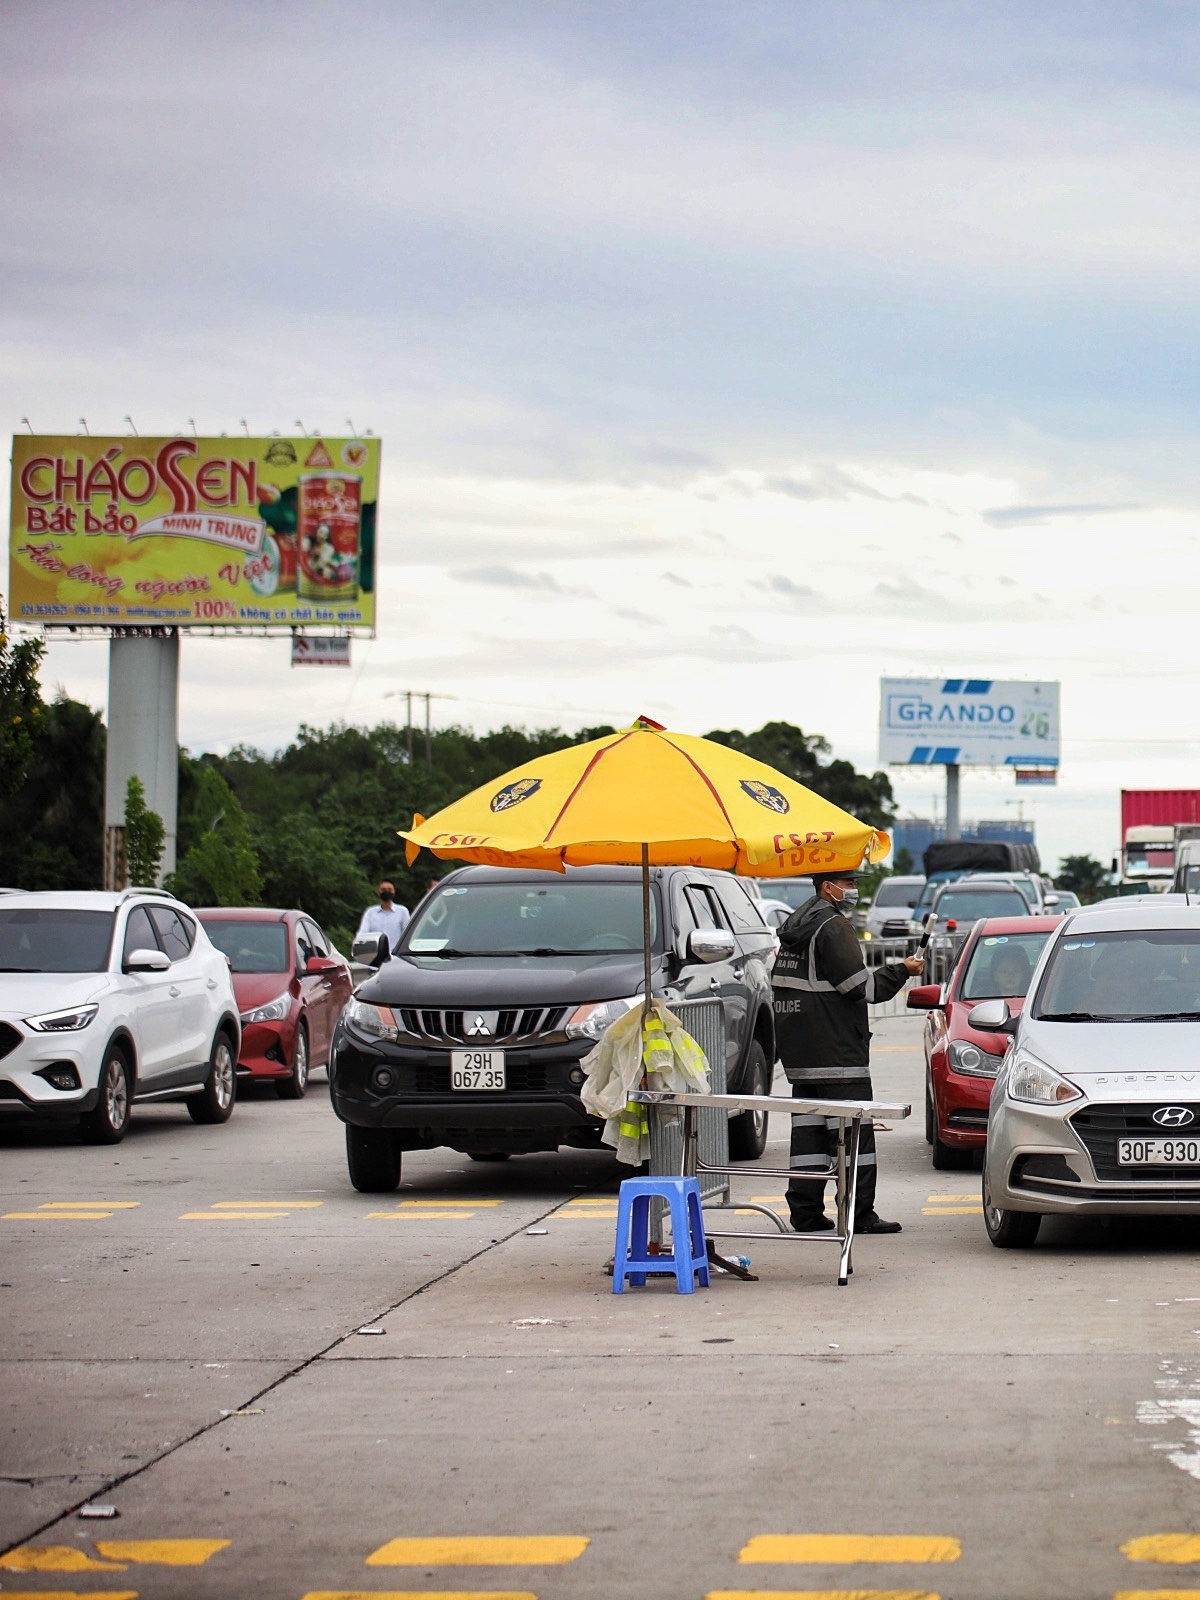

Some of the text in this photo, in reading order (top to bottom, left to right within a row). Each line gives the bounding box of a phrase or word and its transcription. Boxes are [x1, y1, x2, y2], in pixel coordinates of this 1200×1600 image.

[20, 439, 258, 515] CHÁO SEN
[26, 502, 138, 536] Bát bảo
[162, 517, 258, 541] MINH TRUNG
[218, 553, 274, 585] Việt
[194, 600, 237, 619] 100%
[898, 703, 1015, 723] GRANDO
[464, 1053, 492, 1070] 29H
[453, 1071, 504, 1088] 067.35
